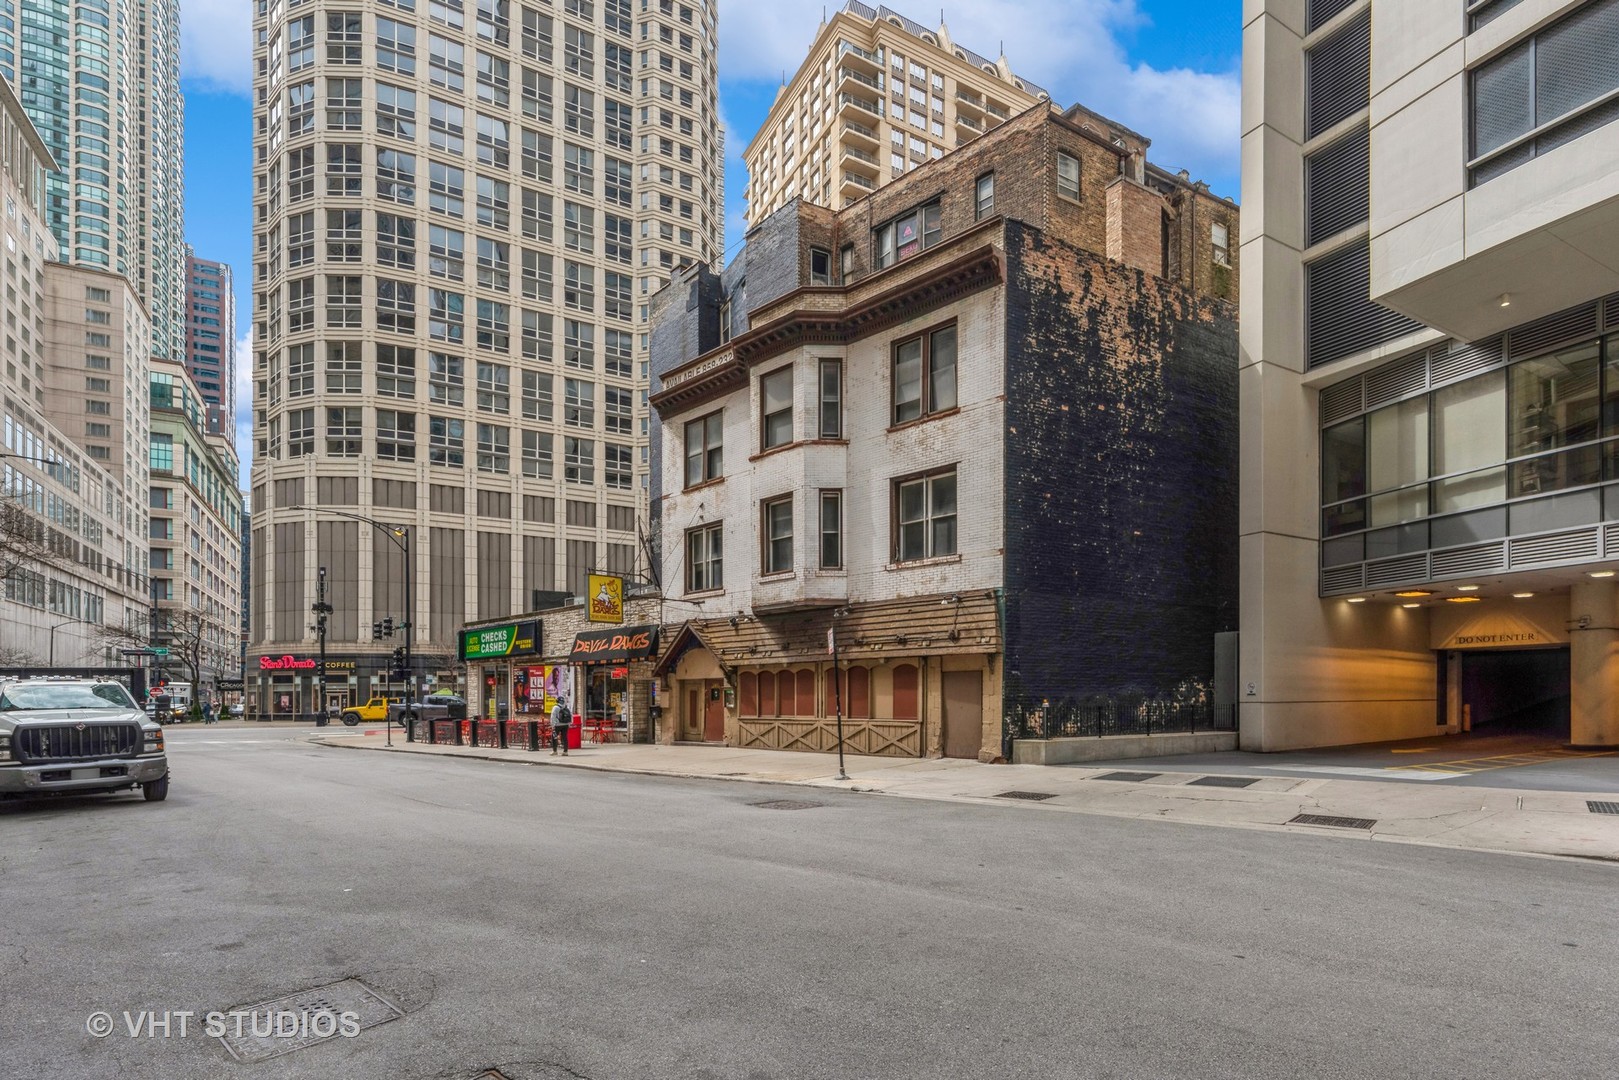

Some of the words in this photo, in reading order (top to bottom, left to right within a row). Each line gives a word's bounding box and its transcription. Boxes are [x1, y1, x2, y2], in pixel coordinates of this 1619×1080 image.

[480, 630, 507, 643] CHECKS
[573, 638, 609, 653] DEVIL
[609, 632, 650, 651] DAWGS
[1458, 636, 1474, 644] DO
[1499, 633, 1535, 641] ENTER
[466, 644, 480, 652] LICENSE
[480, 641, 507, 653] CASHED
[282, 655, 316, 669] Donuts
